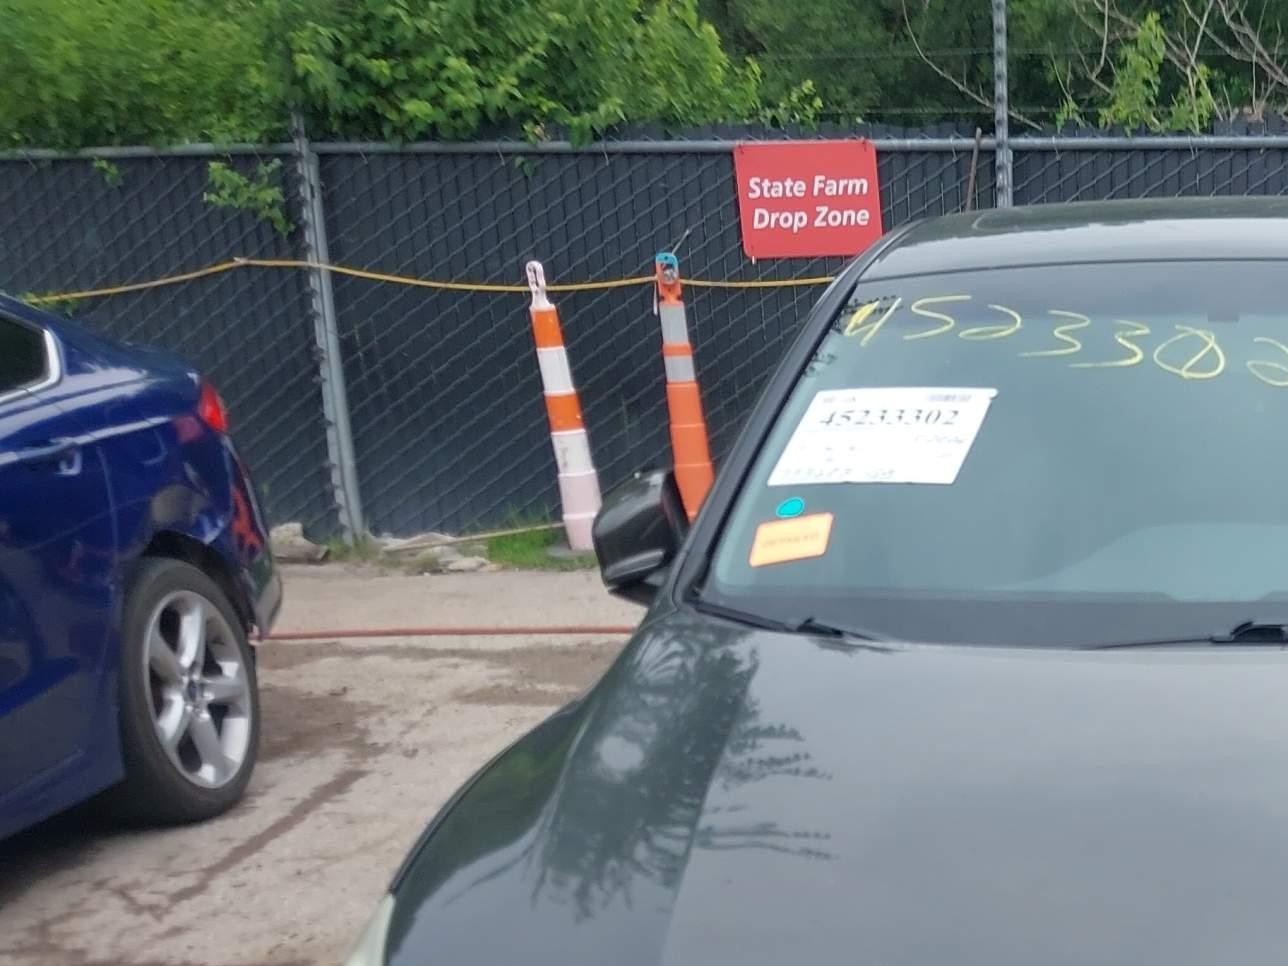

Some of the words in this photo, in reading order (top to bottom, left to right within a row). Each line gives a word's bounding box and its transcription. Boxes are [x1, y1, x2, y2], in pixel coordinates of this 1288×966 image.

[748, 176, 807, 199] State
[812, 174, 869, 197] Farm
[753, 207, 808, 233] Drop
[813, 205, 870, 227] Zone
[819, 408, 960, 426] 45233302
